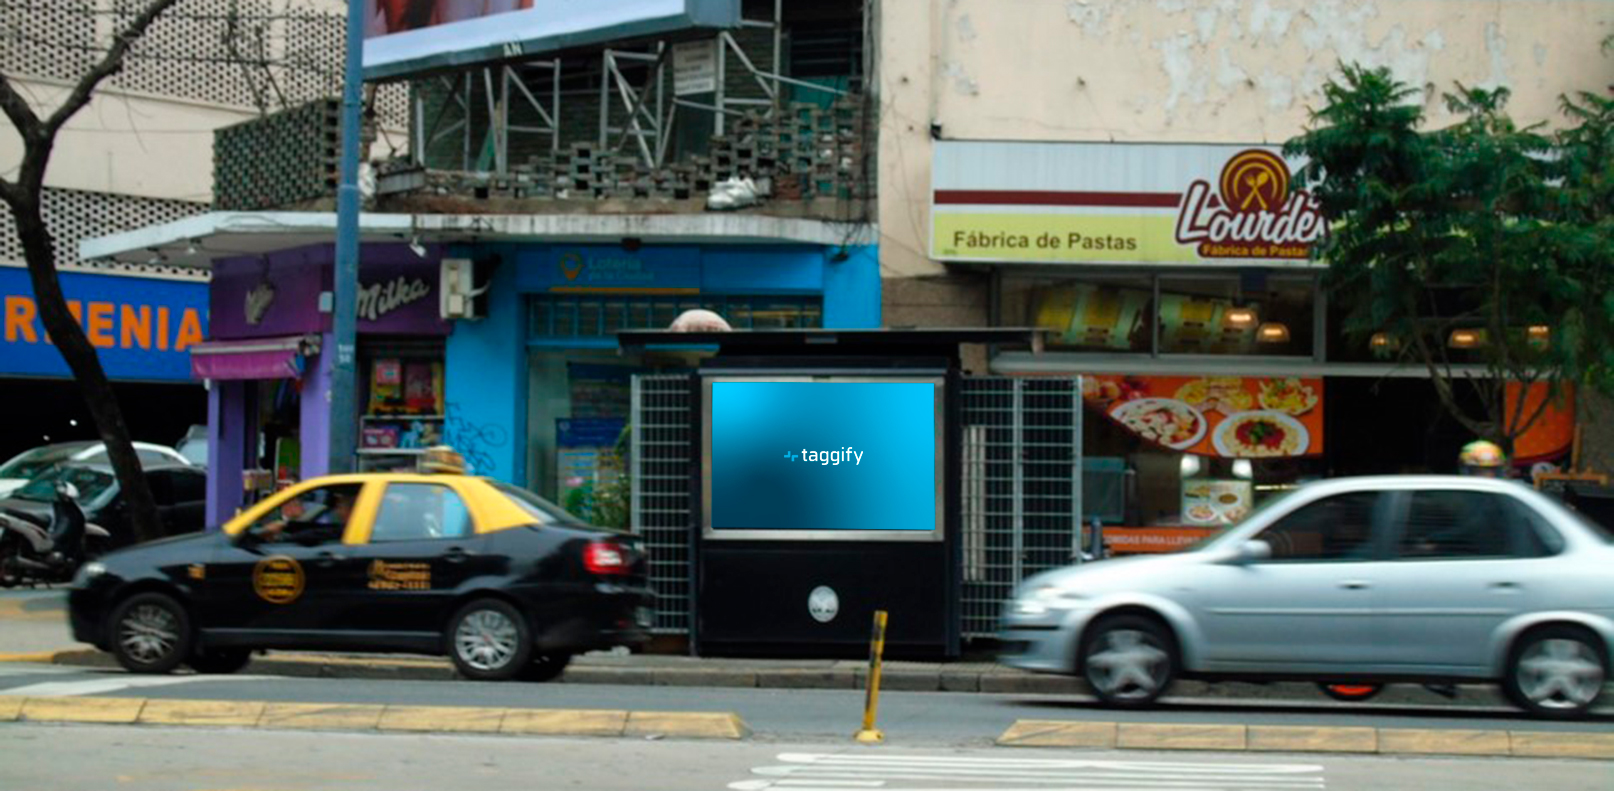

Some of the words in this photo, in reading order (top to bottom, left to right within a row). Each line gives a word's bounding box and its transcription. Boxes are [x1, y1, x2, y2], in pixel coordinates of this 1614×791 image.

[953, 230, 1030, 249] Fábrica
[1035, 231, 1061, 249] de
[1067, 231, 1138, 251] Pastas
[1202, 243, 1249, 256] Fábrica
[1252, 245, 1267, 256] de
[355, 275, 430, 321] Milka
[5, 295, 203, 351] RENIA
[801, 446, 863, 465] taggify
